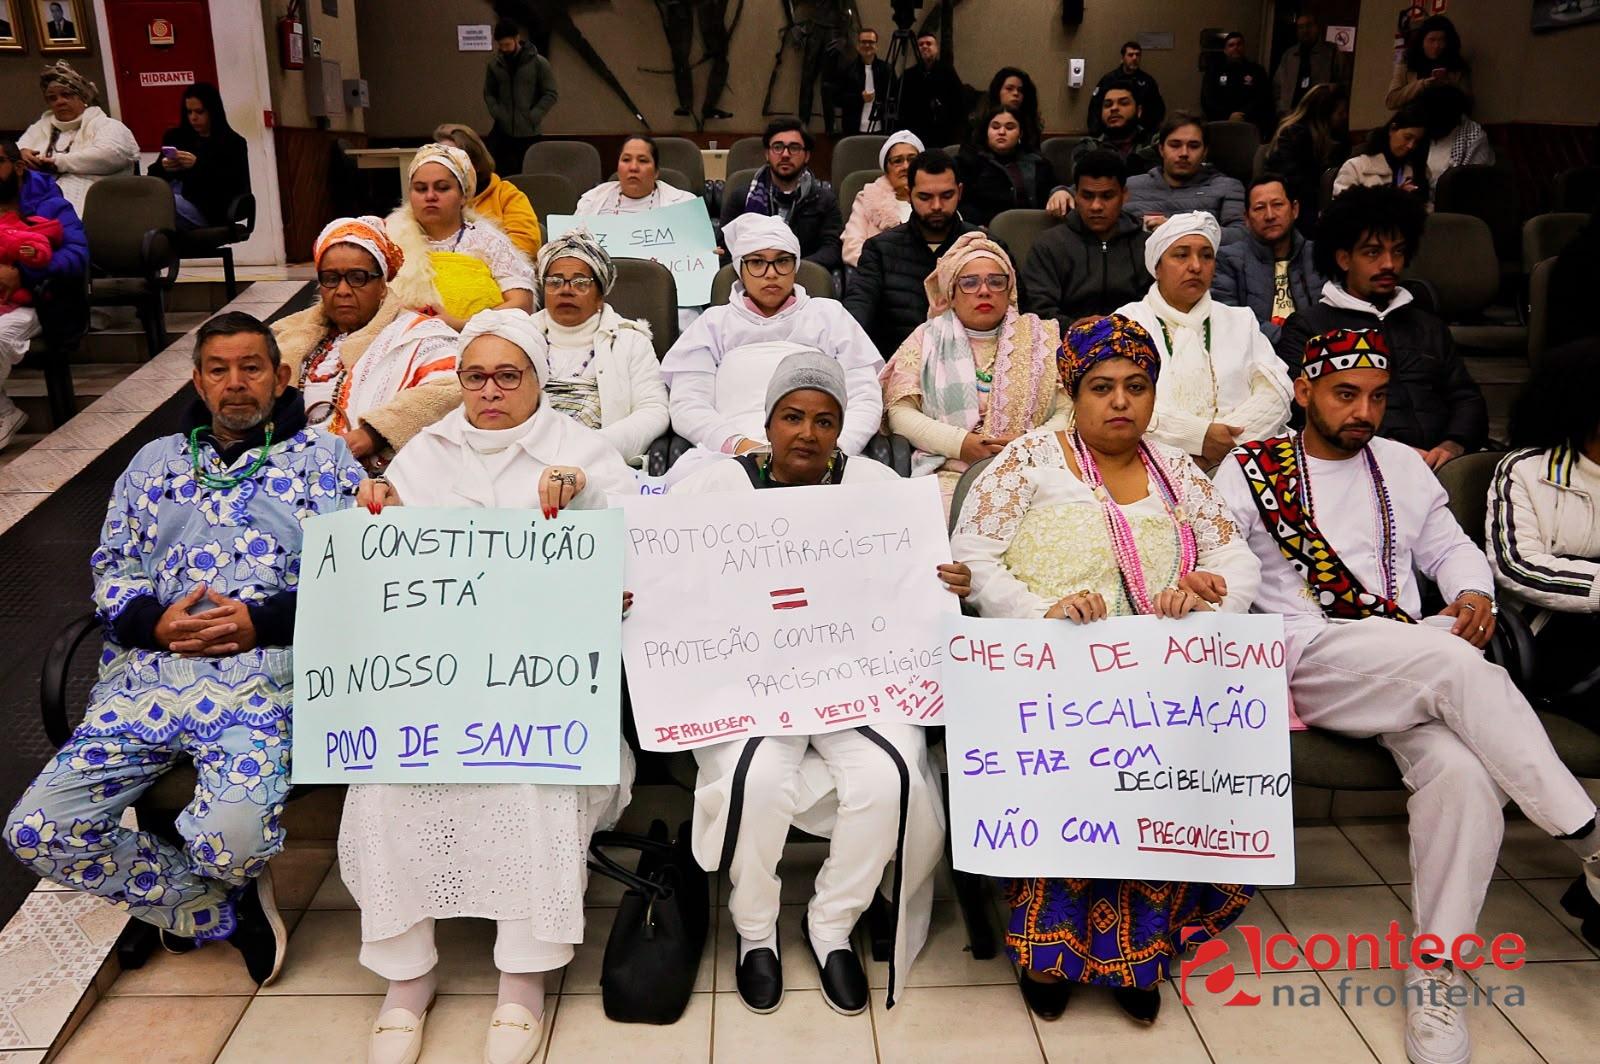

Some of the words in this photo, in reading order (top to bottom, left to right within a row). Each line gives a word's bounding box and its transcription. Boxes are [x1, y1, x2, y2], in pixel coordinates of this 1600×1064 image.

[141, 72, 193, 83] HIDRANTE
[628, 227, 674, 245] SEM
[316, 533, 337, 580] A
[361, 519, 595, 565] CONSTITUIÇÃO
[628, 517, 790, 556] PROTOCOLO
[720, 526, 912, 575] ANTIRRACISTA
[383, 571, 485, 613] ESTÁ
[643, 625, 760, 669] PROTEÇÃO
[773, 621, 855, 650] CONTRA
[871, 615, 887, 633] O
[948, 634, 1057, 672] CHEGA
[1089, 641, 1139, 673] DE
[1163, 632, 1286, 672] ACHISMO
[305, 665, 335, 702] DO
[347, 653, 458, 695] NOSSO
[486, 651, 600, 695] LADO!
[746, 666, 853, 698] RACISMO
[853, 645, 943, 677] RELIGIOS
[655, 714, 756, 743] DERRUBEM
[779, 711, 791, 724] O
[814, 694, 881, 718] VETO!
[884, 683, 907, 700] PL
[896, 679, 939, 717] 323
[1018, 684, 1267, 734] FISCALIZAÇÃO
[326, 725, 378, 768] POVO
[398, 723, 440, 758] DE
[456, 719, 589, 757] SANTO
[962, 748, 1007, 777] SE
[1016, 748, 1070, 776] FAZ
[1088, 743, 1162, 770] COM
[1113, 765, 1291, 798] DECIBELÍMETRO
[973, 807, 1040, 851] NÃO
[1060, 816, 1121, 846] COM
[1137, 818, 1271, 853] PRECONCEITO
